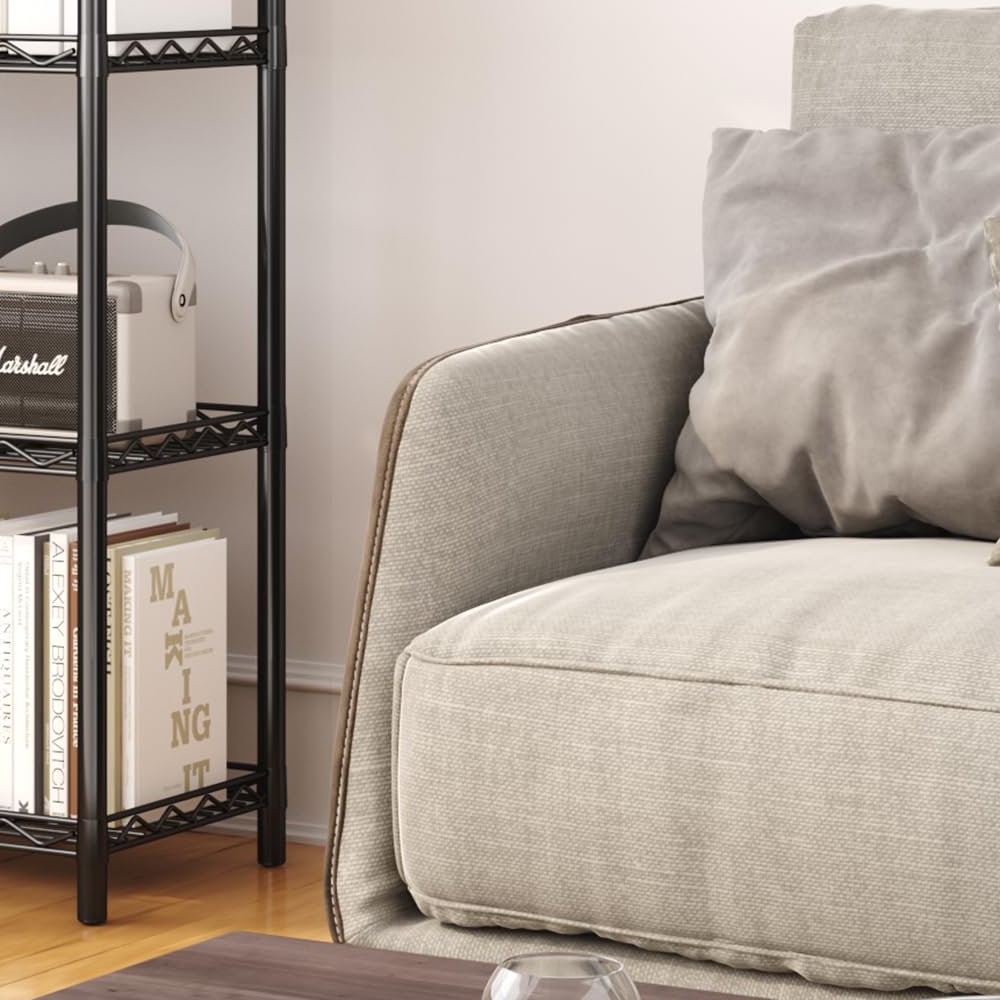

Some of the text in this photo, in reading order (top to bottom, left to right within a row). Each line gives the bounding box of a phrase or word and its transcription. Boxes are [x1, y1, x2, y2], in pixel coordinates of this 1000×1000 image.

[123, 569, 132, 637] MAKING
[1, 609, 11, 745] ANTIQUAIRES
[52, 542, 64, 803] ALEXEY BRODOVITCH
[123, 641, 132, 658] IT
[182, 758, 211, 794] IT
